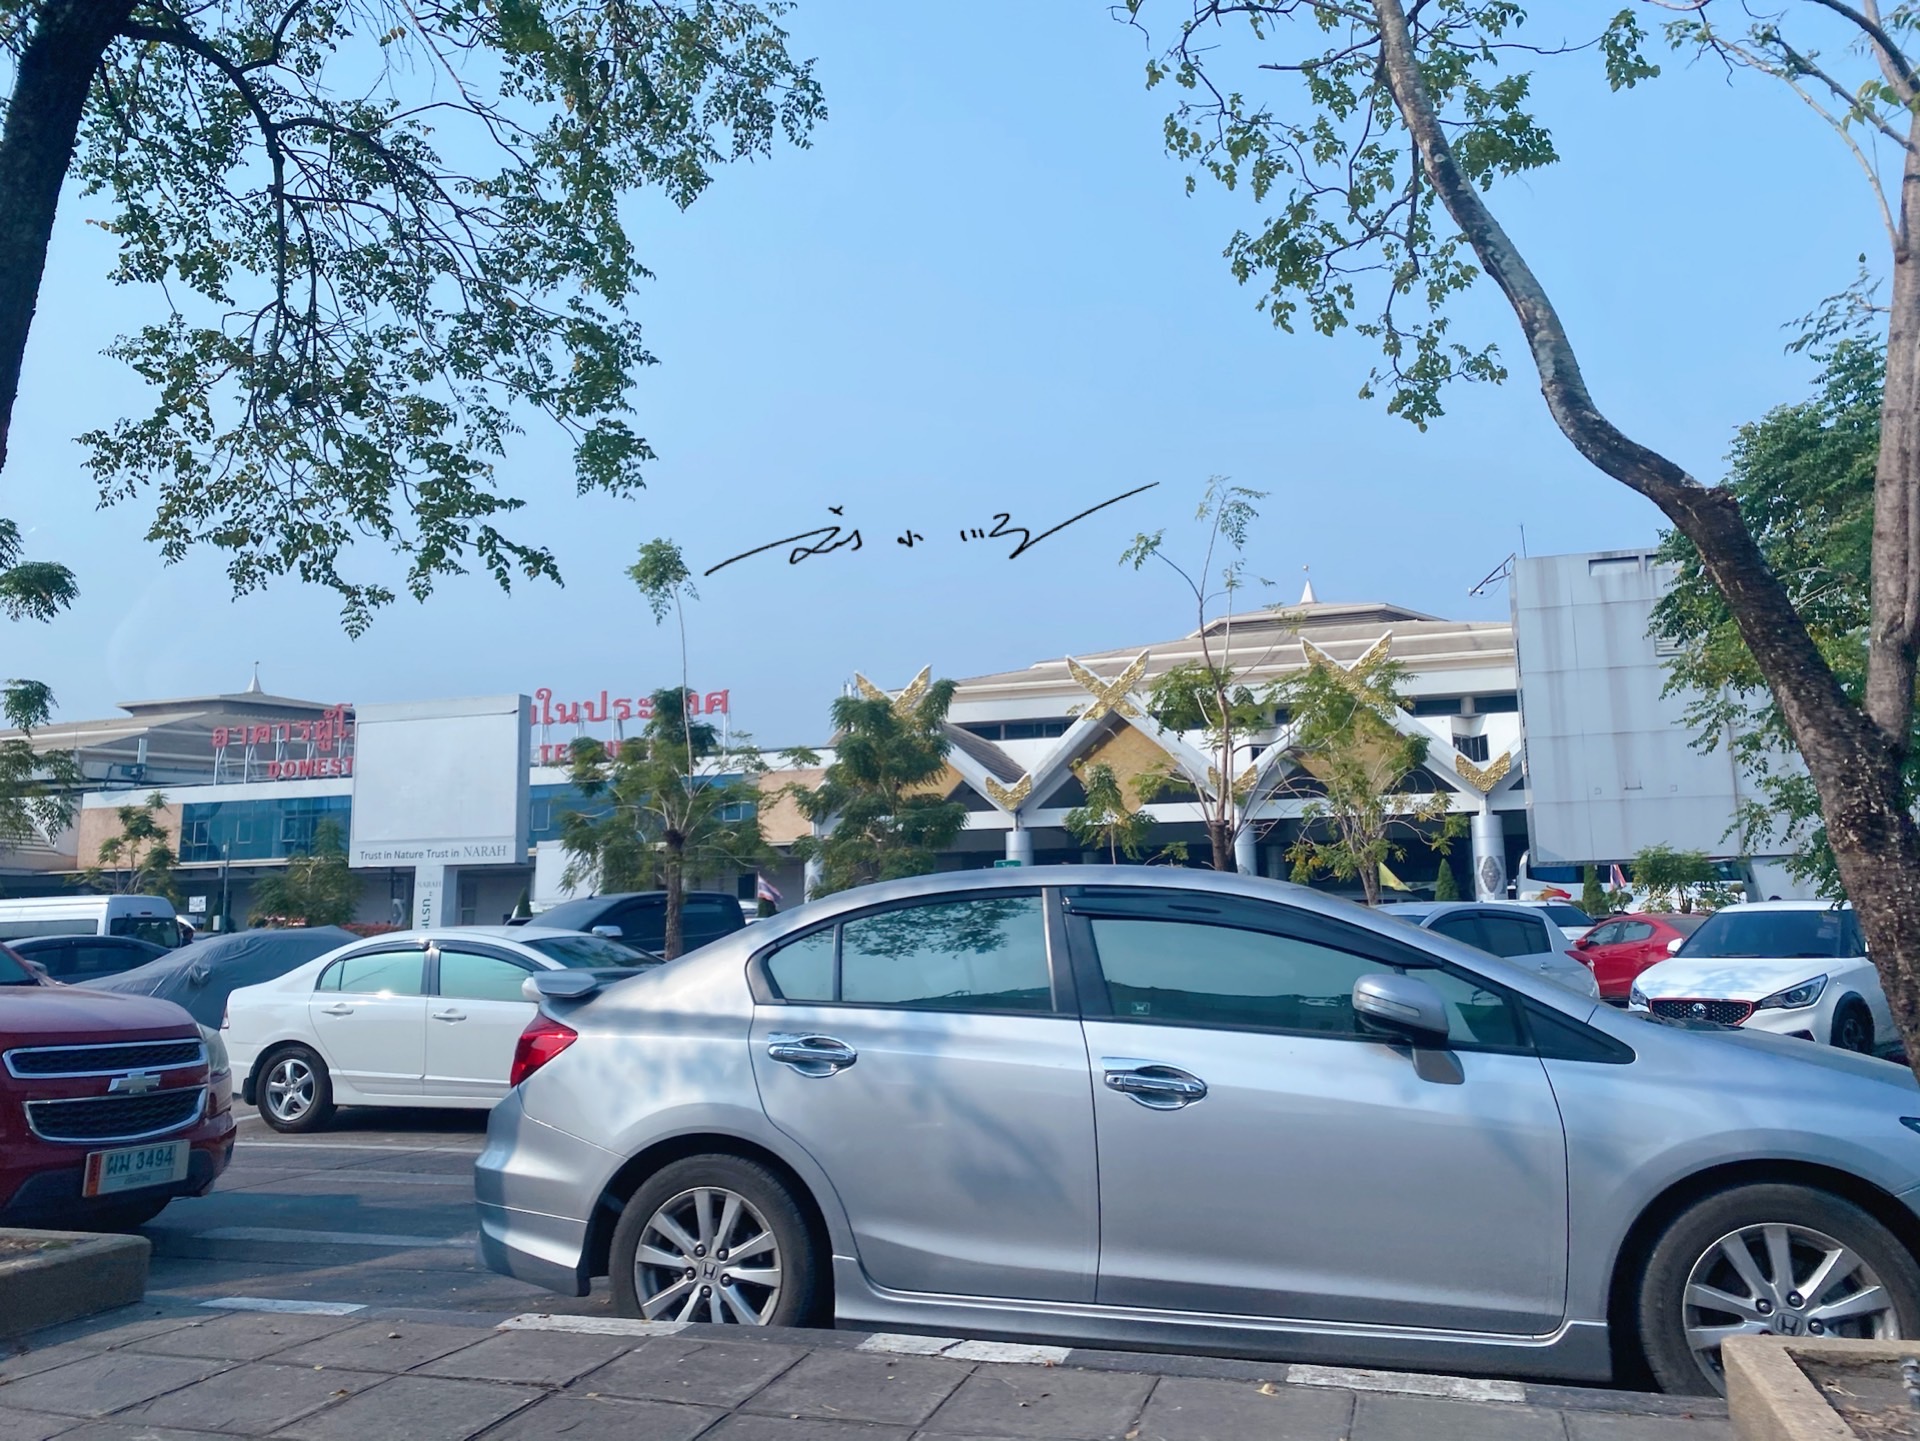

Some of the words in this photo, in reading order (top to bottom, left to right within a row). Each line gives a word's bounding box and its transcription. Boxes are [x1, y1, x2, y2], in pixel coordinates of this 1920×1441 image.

[360, 851, 382, 860] Trust
[383, 850, 392, 860] in
[393, 850, 424, 860] Nature
[426, 849, 449, 859] Trust
[450, 848, 460, 858] in
[464, 845, 506, 857] NARAH
[136, 1146, 174, 1169] 3494
